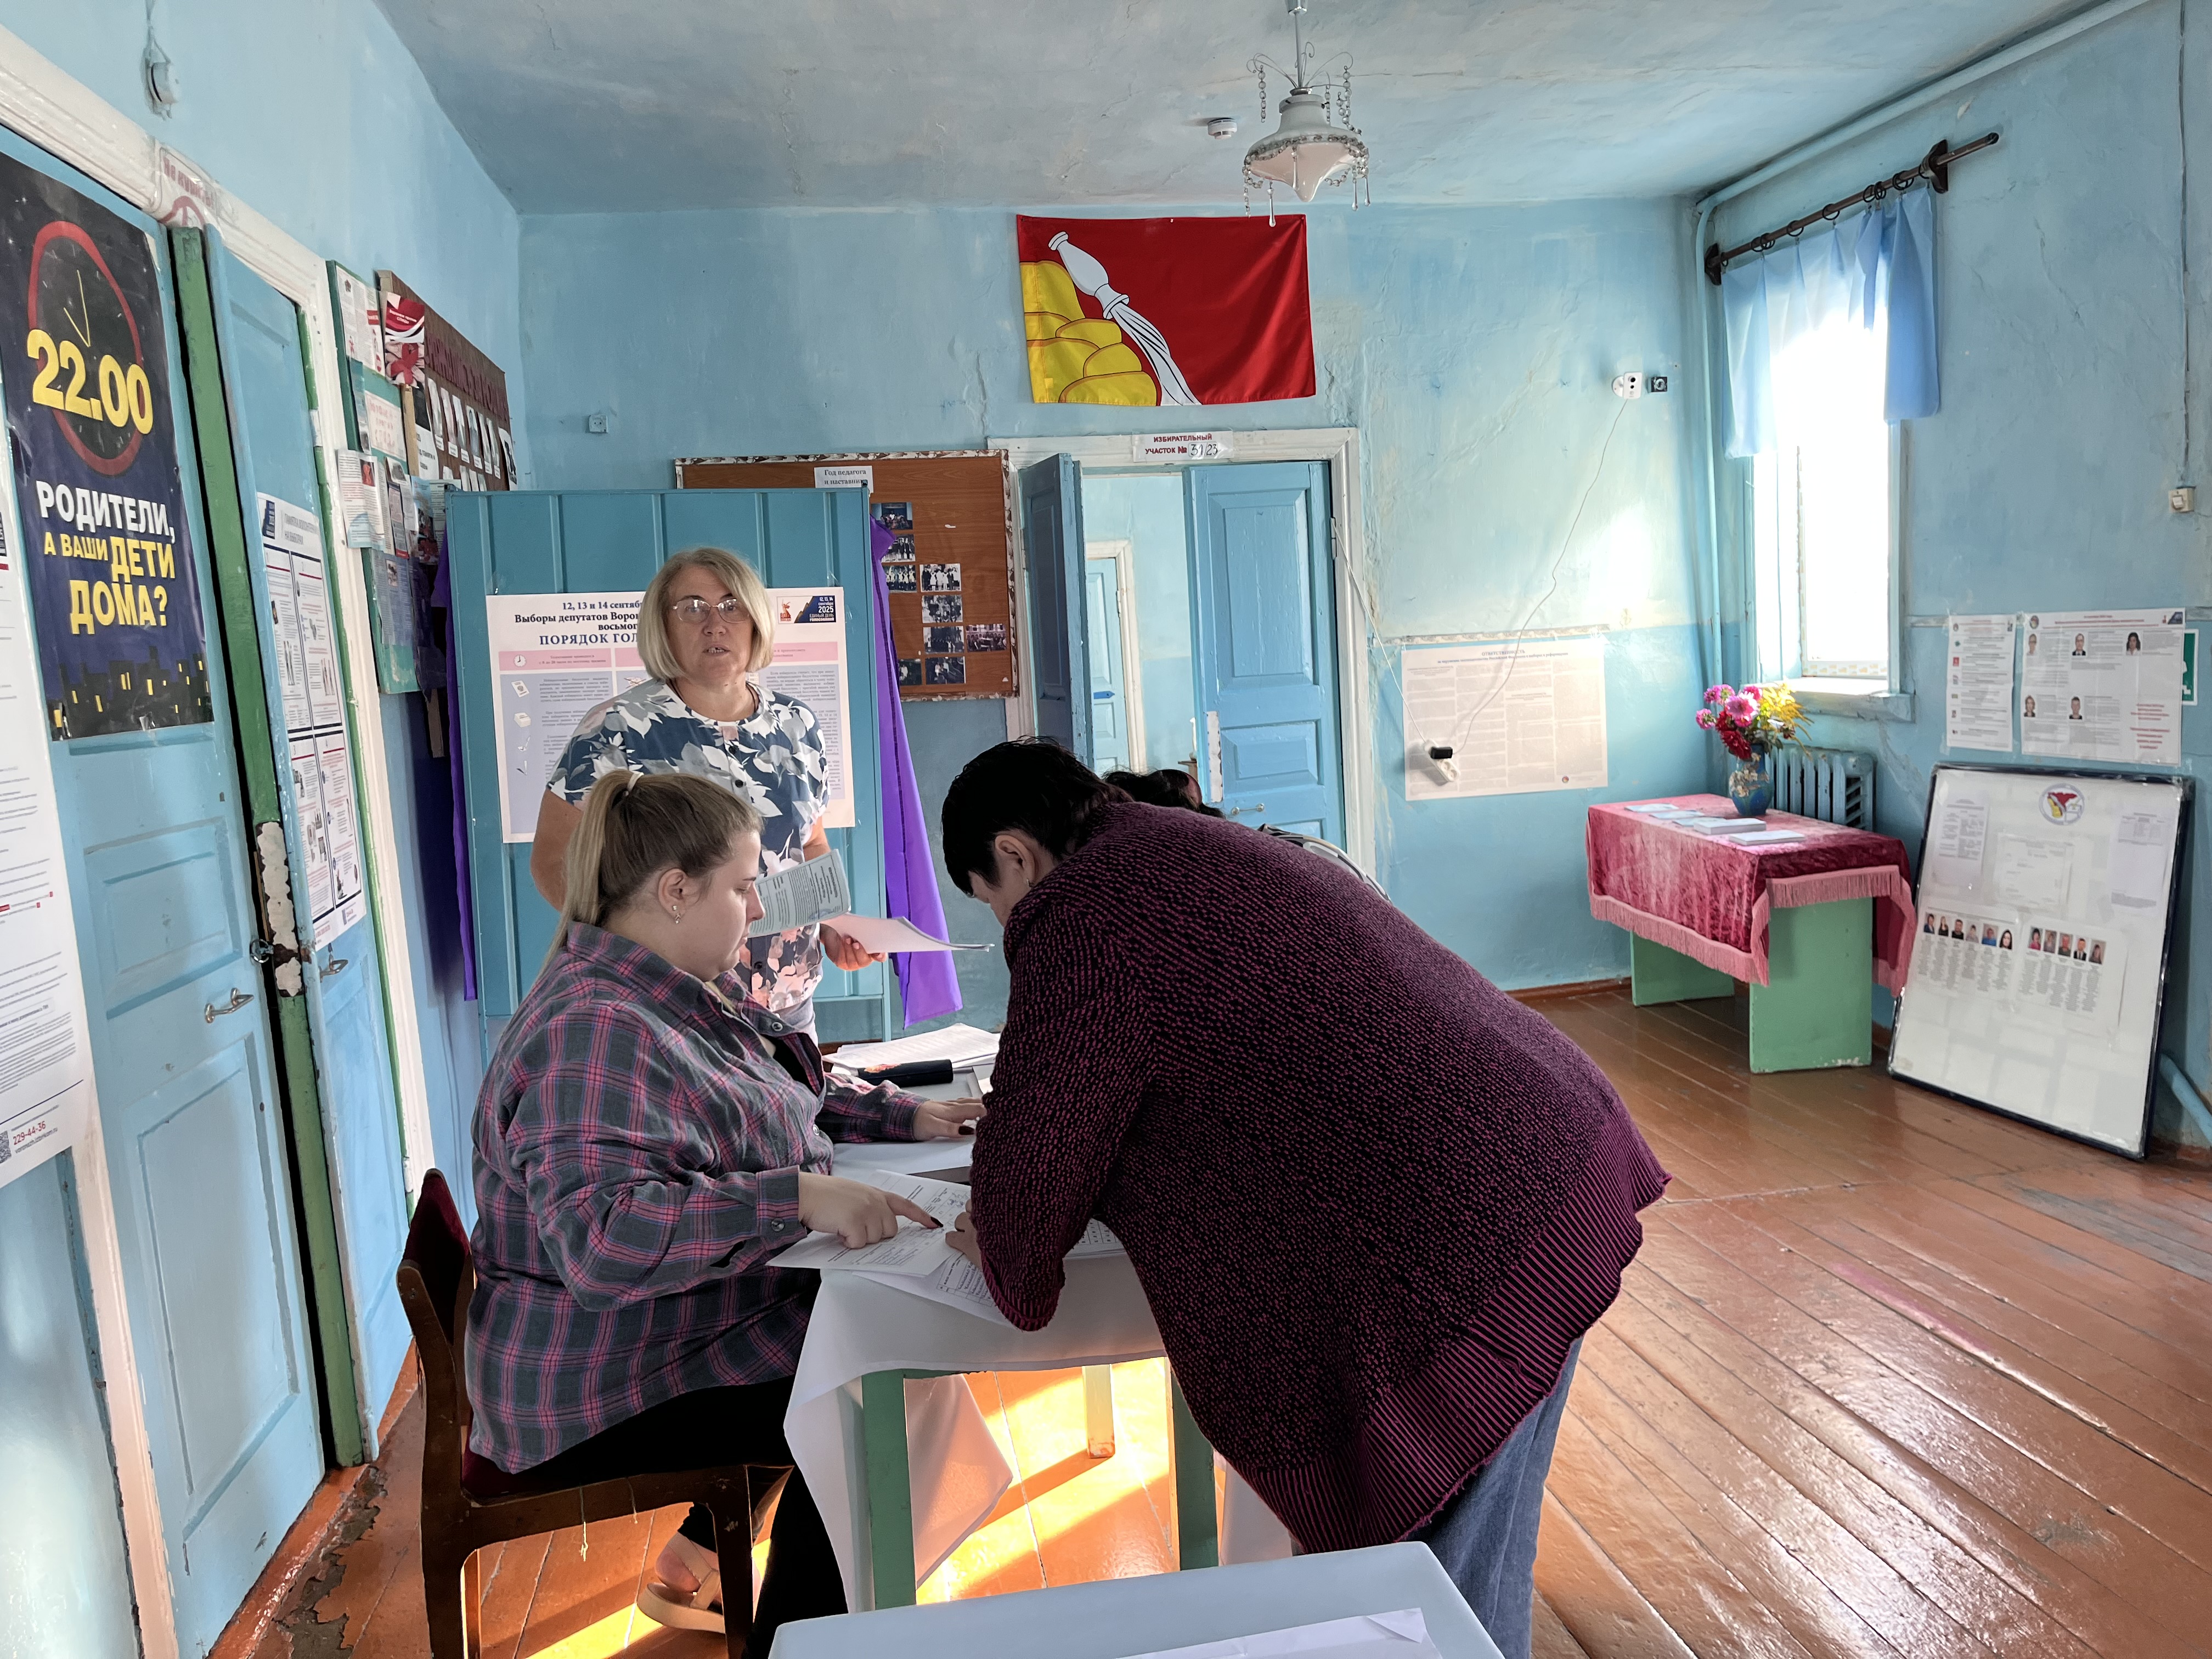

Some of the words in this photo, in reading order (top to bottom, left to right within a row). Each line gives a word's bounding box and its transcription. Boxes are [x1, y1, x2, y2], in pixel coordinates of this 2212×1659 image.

[27, 329, 154, 435] 22.00
[1154, 433, 1212, 443] ИЗБИРАТЕЛЬНЫЙ
[36, 481, 175, 544] РОДИТЕЛИ,
[44, 532, 57, 555] А
[60, 534, 109, 561] ВАШИ
[110, 536, 176, 583] ДЕТИ
[70, 580, 167, 635] ДОМА?
[610, 600, 641, 608] сентяб
[515, 613, 556, 624] Выборы
[558, 614, 608, 623] депутатов
[539, 634, 609, 646] ПОРЯДОК
[13, 1120, 46, 1146] 229-44-36
